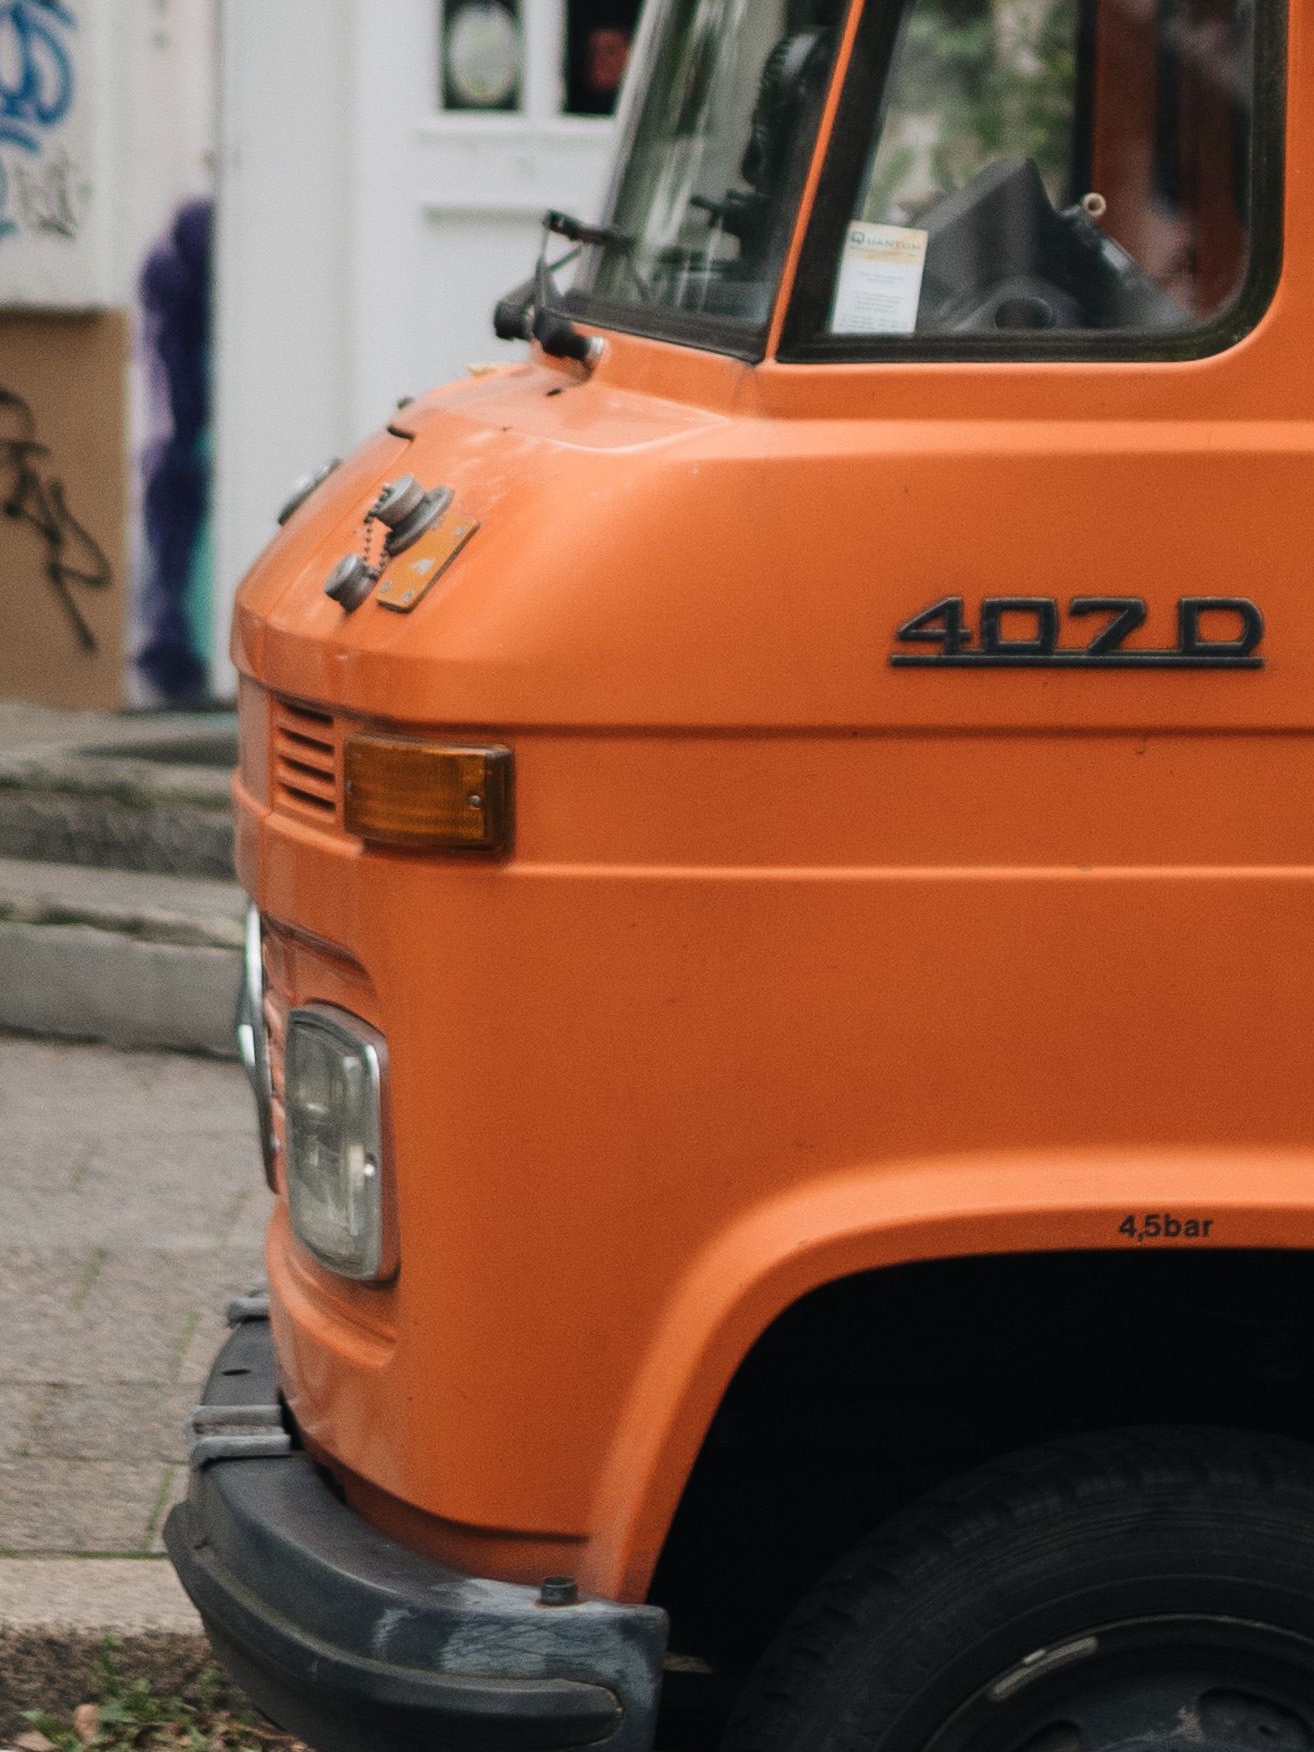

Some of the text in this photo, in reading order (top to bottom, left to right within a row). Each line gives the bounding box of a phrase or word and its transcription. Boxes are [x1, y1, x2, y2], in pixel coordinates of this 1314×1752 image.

[896, 596, 1265, 657] 407 D
[1119, 1213, 1213, 1243] 4,5bar
